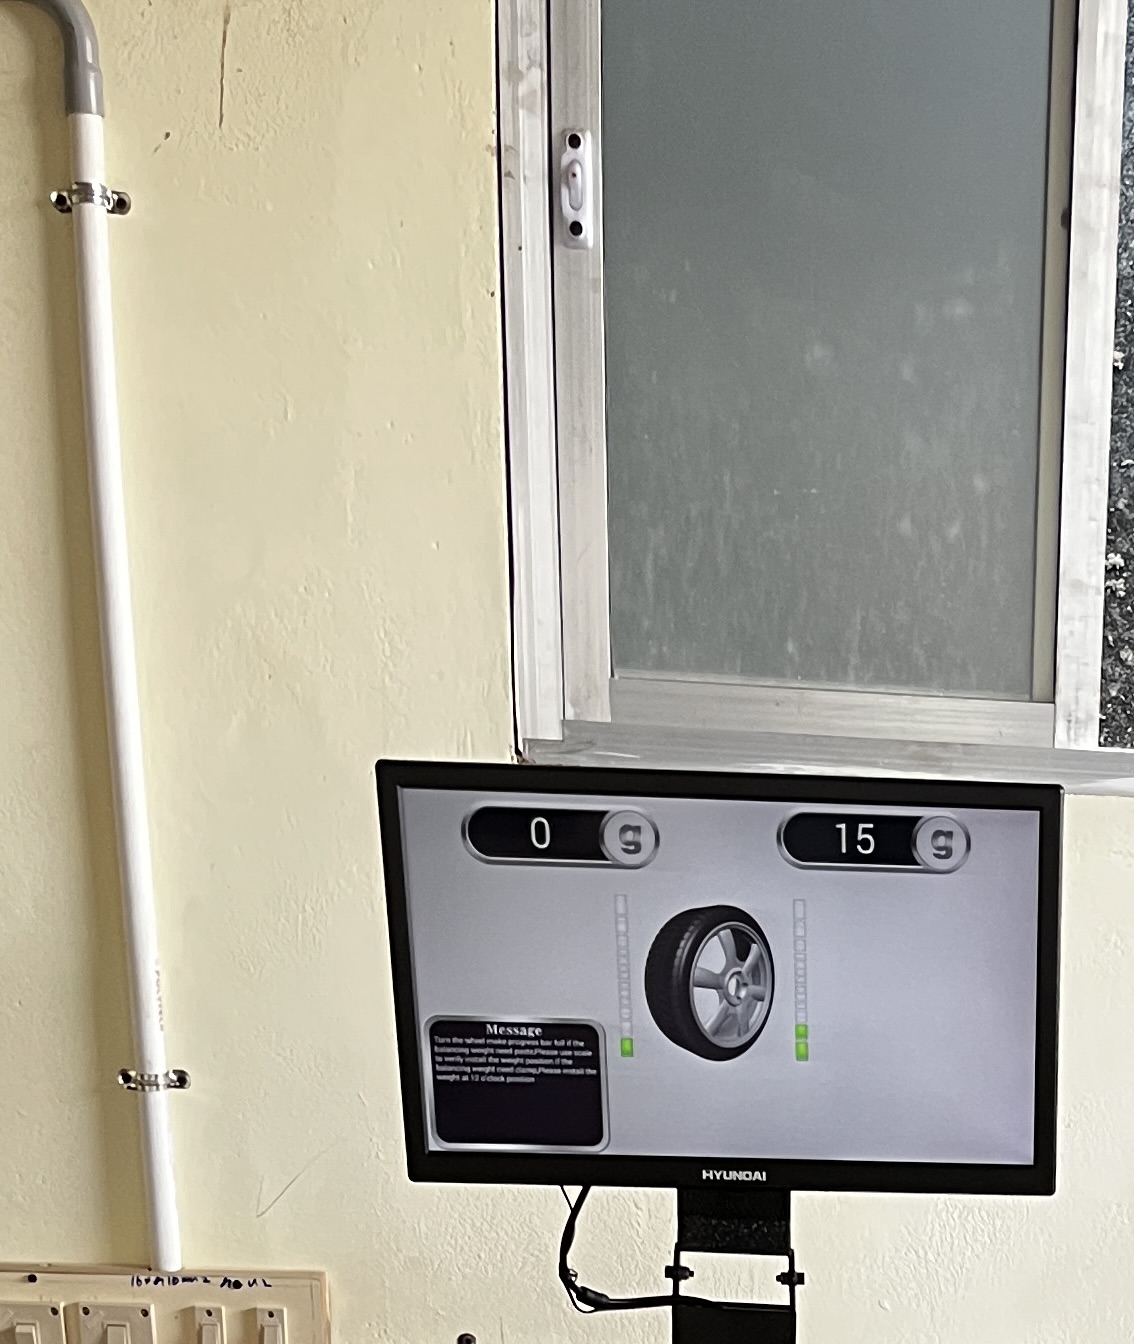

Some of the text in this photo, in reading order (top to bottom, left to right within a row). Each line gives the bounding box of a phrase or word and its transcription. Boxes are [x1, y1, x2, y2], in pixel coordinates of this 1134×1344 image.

[530, 816, 551, 849] 0
[835, 822, 875, 855] 15
[485, 1024, 543, 1037] Message
[702, 1169, 767, 1182] HYUNDAI
